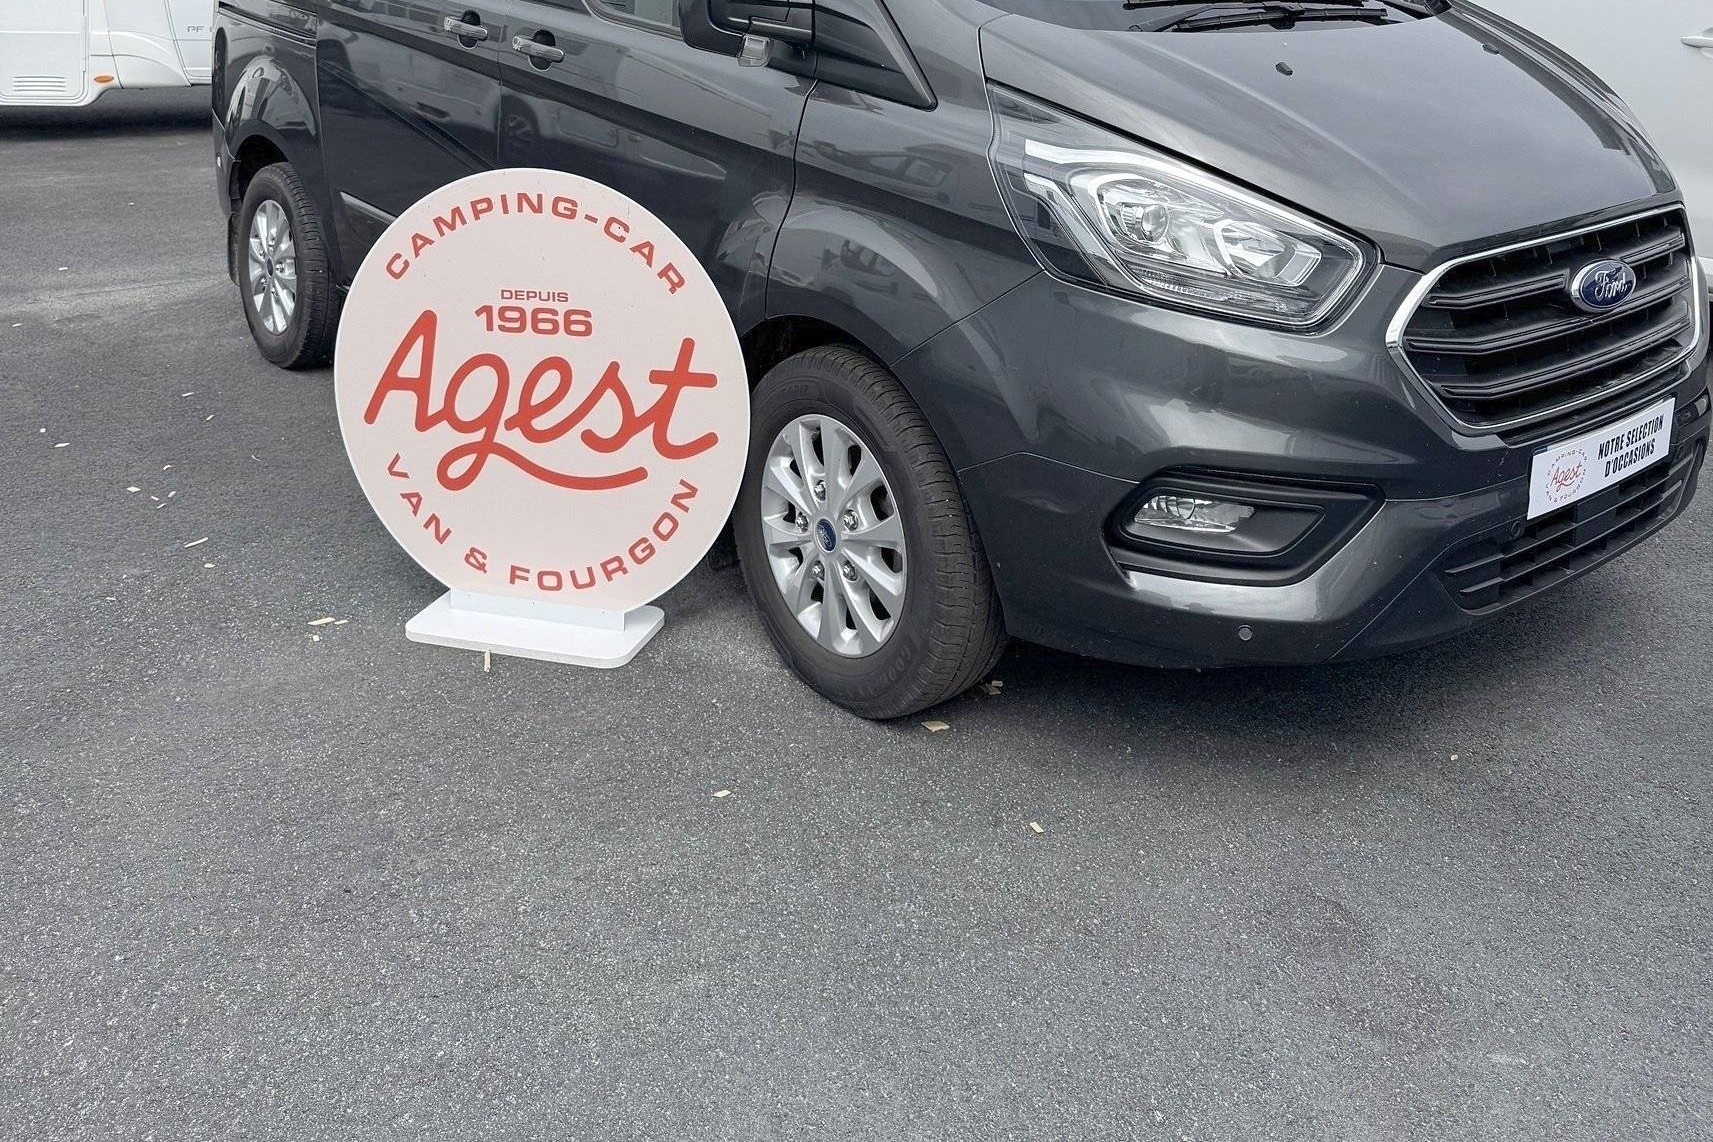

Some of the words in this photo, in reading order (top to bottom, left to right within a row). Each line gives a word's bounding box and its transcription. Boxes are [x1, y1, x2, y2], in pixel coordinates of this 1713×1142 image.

[386, 192, 686, 294] CAMPING-CAR
[500, 289, 569, 303] DEPUIS
[1595, 268, 1628, 298] Ford
[474, 305, 593, 337] 1966
[363, 309, 719, 491] Agest
[1598, 433, 1625, 460] NOTRE
[1626, 414, 1665, 448] SELECTION
[1550, 460, 1583, 492] Agest
[1604, 438, 1656, 478] D'OCCASIONS
[386, 452, 453, 545] VAN
[464, 547, 489, 574] &
[508, 479, 699, 592] FOURGON
